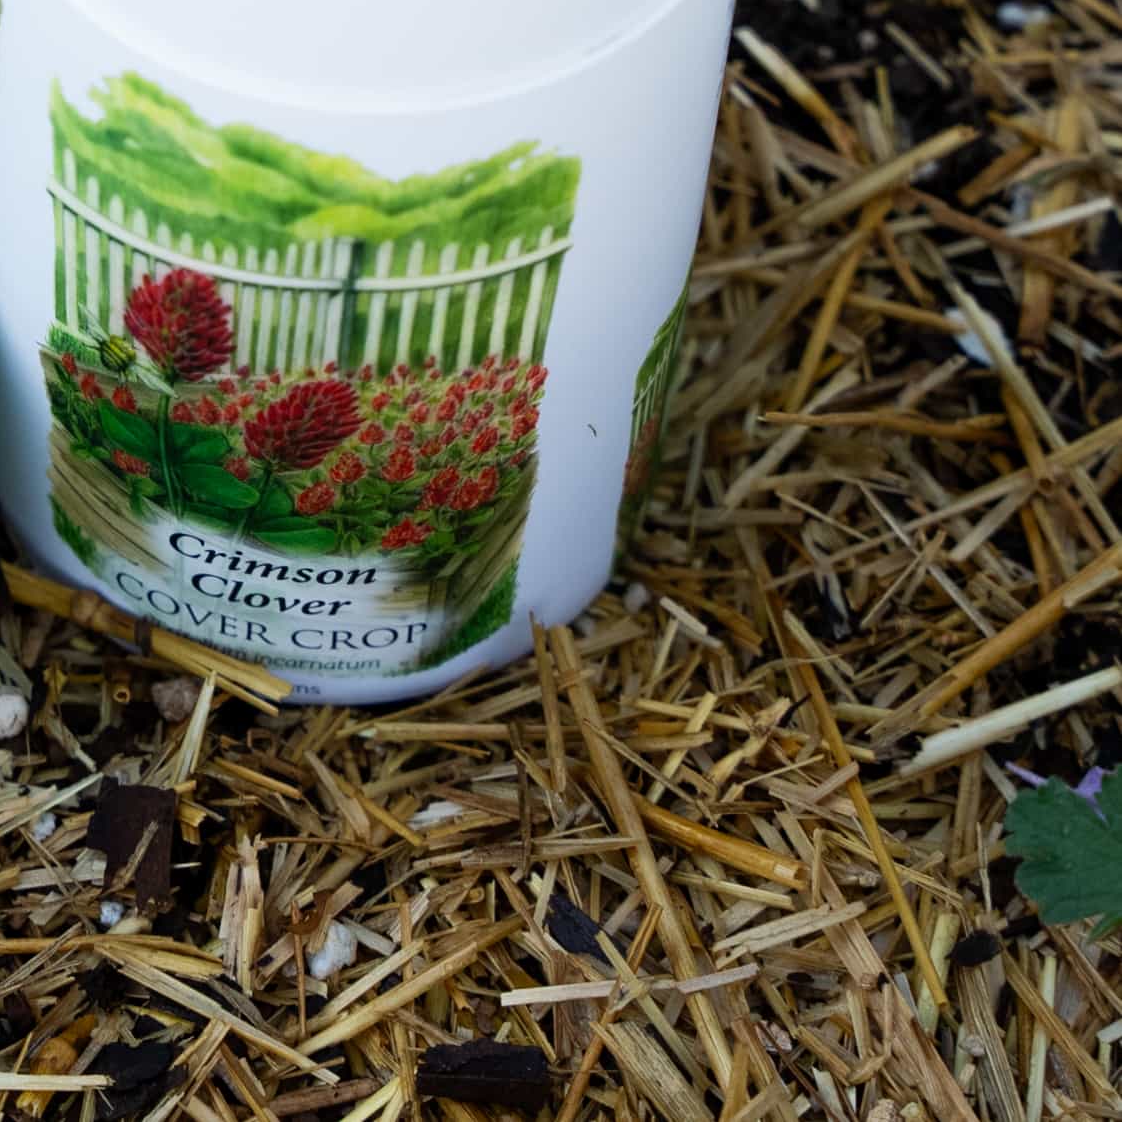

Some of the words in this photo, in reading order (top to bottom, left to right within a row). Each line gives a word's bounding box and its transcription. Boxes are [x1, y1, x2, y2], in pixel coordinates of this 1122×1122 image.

[168, 531, 378, 587] Crimson
[114, 571, 278, 647] COVER
[290, 621, 428, 651] CROP
[190, 572, 352, 617] Clover
